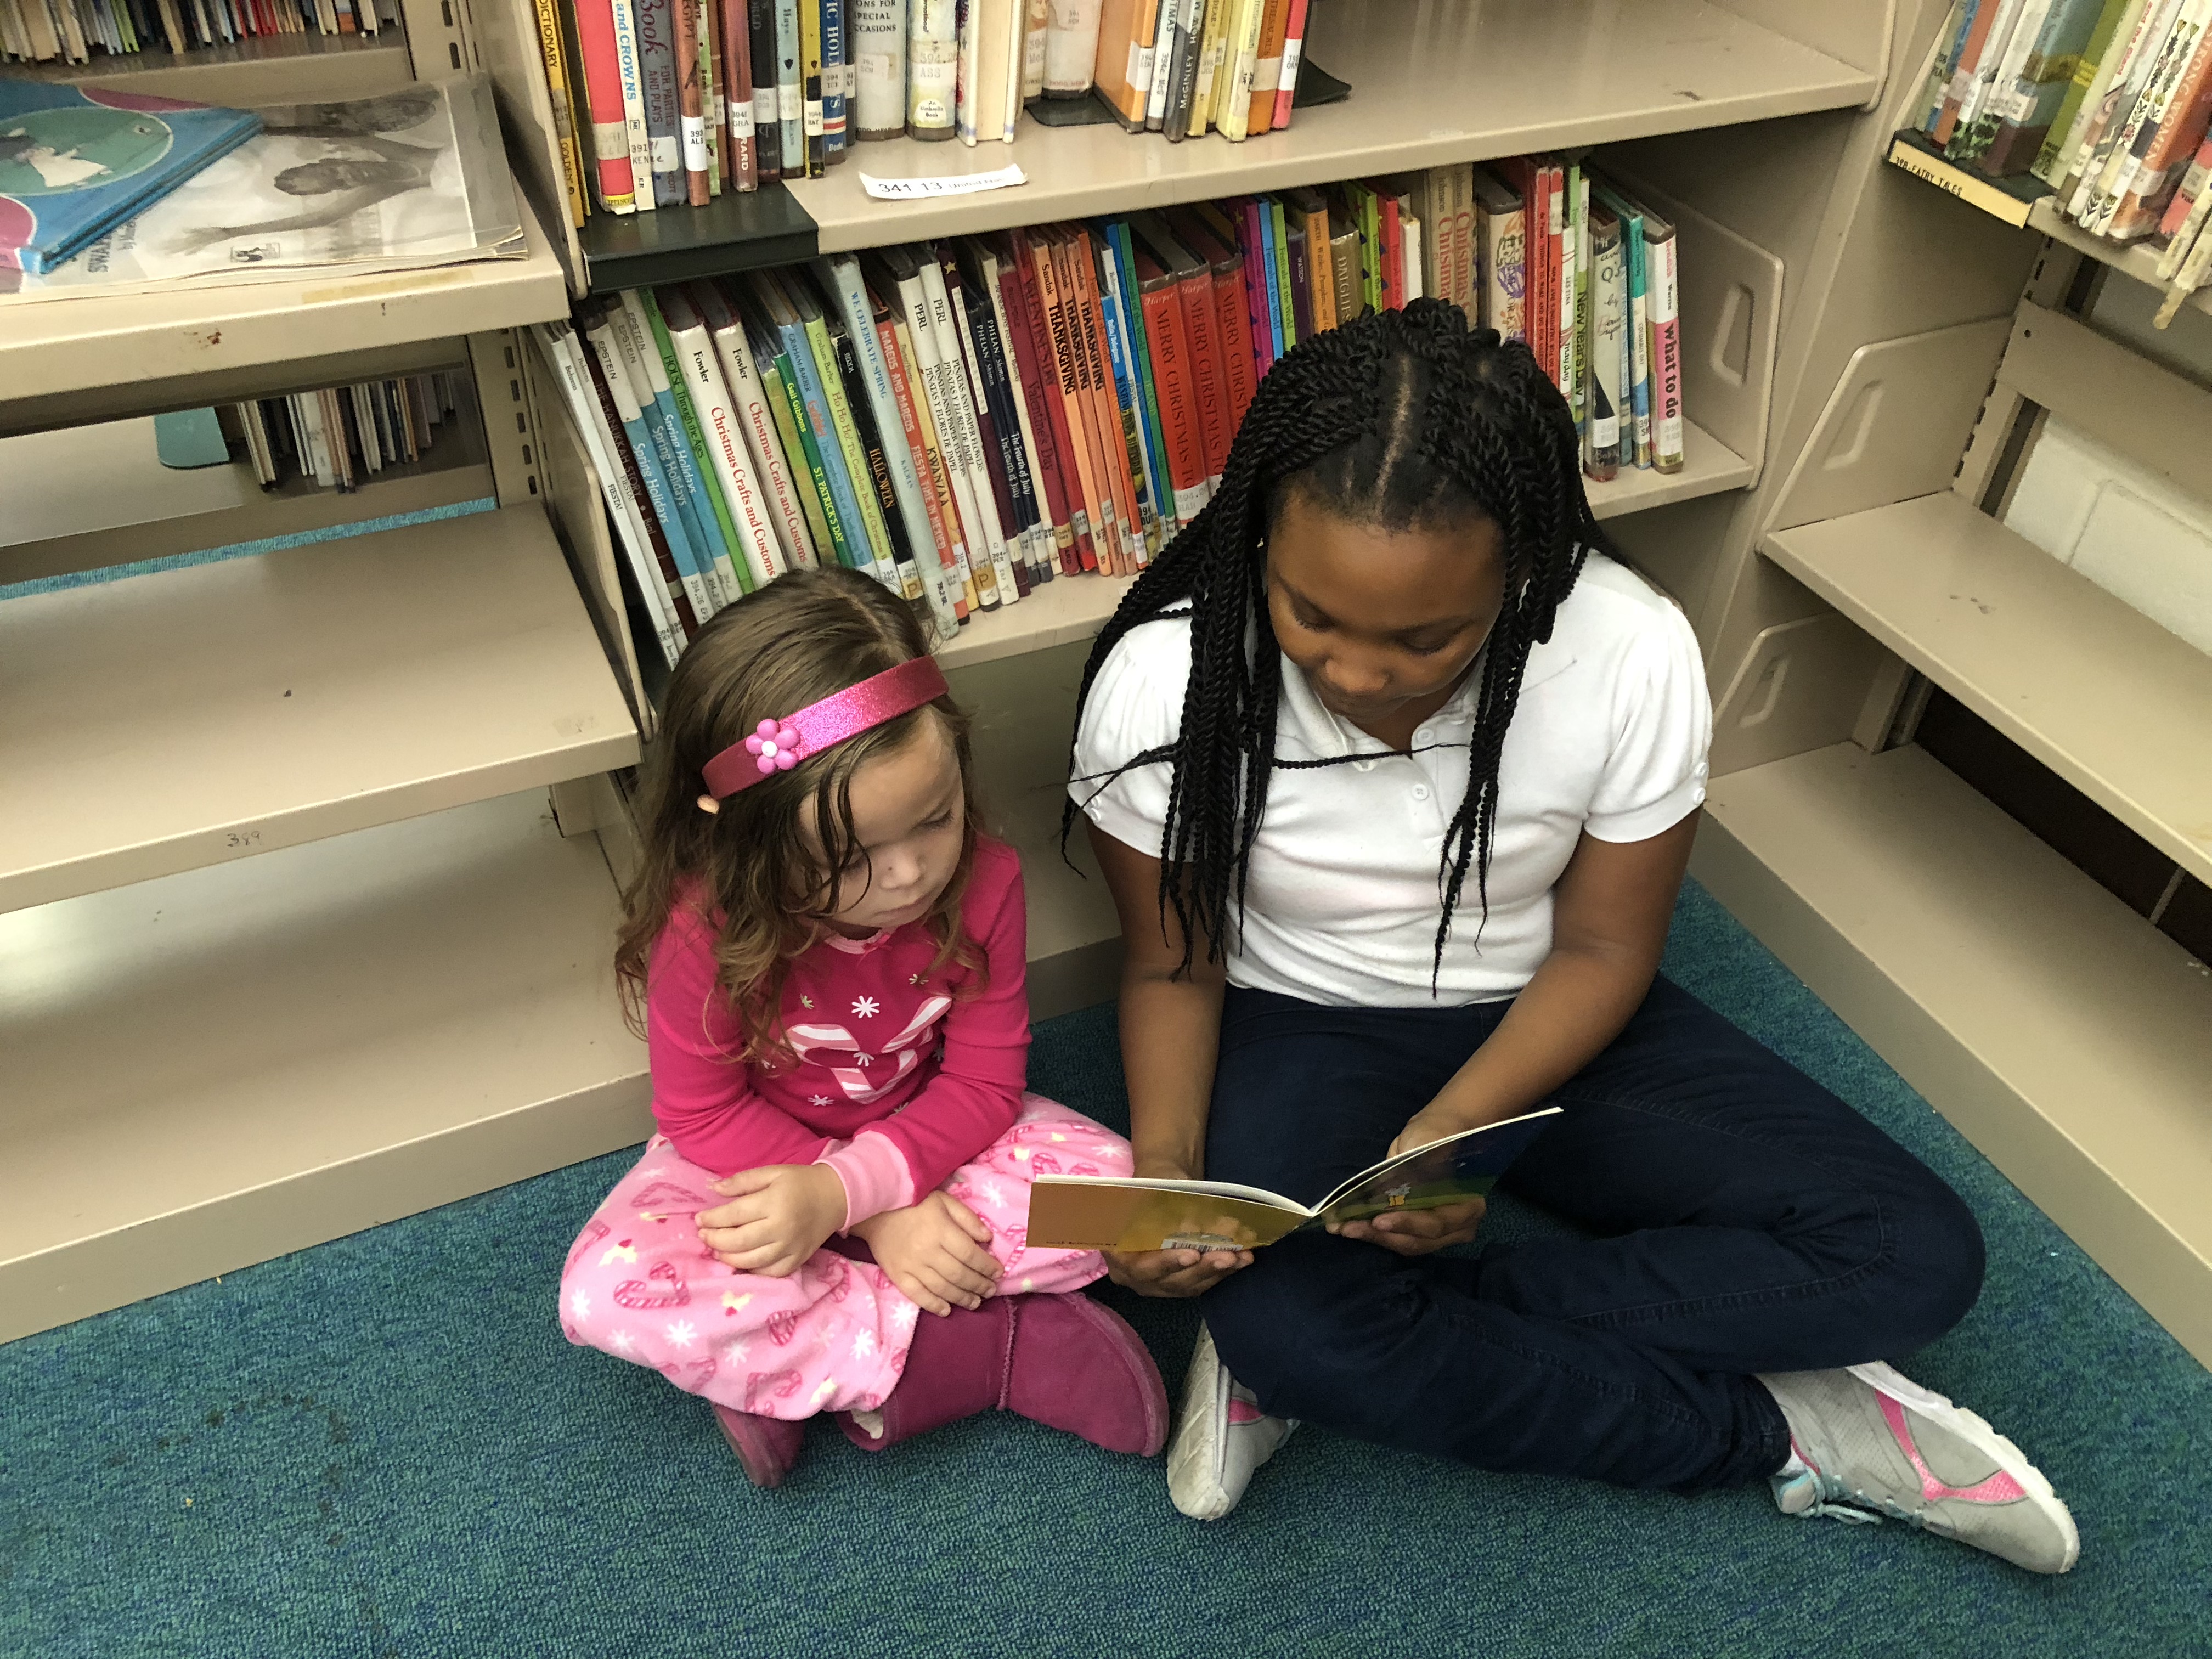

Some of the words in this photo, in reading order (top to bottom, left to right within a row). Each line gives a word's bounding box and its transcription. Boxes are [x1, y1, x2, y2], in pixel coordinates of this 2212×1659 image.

[616, 3, 629, 31] and
[648, 70, 659, 90] AND
[661, 66, 670, 84] FOR
[919, 67, 941, 78] ASS
[1180, 55, 1194, 109] McGINLEY
[664, 88, 675, 127] PARTIES
[878, 183, 912, 193] 341
[921, 182, 943, 190] 13
[1437, 177, 1447, 212] Johnson
[1265, 246, 1274, 279] Festivals
[1279, 246, 1289, 281] Festivals
[1438, 217, 1453, 301] Christma
[1456, 212, 1471, 301] Christmas
[1268, 279, 1274, 289] of
[1282, 280, 1288, 290] of
[914, 302, 928, 331] PERL
[933, 298, 947, 326] PERL
[1058, 258, 1069, 291] Sandak
[1065, 295, 1090, 391] THANKSGIVING
[1222, 291, 1240, 348] MERRY
[1271, 305, 1280, 330] World
[1285, 306, 1294, 330] World
[1576, 291, 1585, 325] New
[628, 312, 646, 351] EPSTEIN
[1042, 263, 1054, 296] Sandak
[1048, 301, 1076, 396] THANKSGIVING
[1074, 259, 1085, 291] Sandak
[1080, 297, 1105, 392] THANKSGIVING
[1155, 308, 1176, 365] MERRY
[1190, 298, 1209, 353] MERRY
[598, 340, 618, 380] EPSTEIN
[618, 324, 637, 364] EPSTEIN
[815, 332, 827, 361] Graham
[851, 291, 861, 307] WE
[856, 308, 878, 365] CELEBRATE
[873, 365, 888, 399] SPRING
[663, 355, 680, 387] HOUSE
[693, 350, 710, 384] Fowler
[732, 347, 748, 380] Fowler
[788, 332, 802, 368] GRAHAM
[798, 367, 812, 393] BARBER
[823, 360, 834, 385] Barber
[787, 382, 798, 400] Gail
[832, 391, 843, 407] Ho
[1229, 352, 1249, 424] CHRIST
[1575, 370, 1585, 396] Day
[1664, 375, 1677, 394] to
[677, 391, 693, 424] Through
[792, 399, 807, 433] Gibbons
[837, 407, 846, 423] Ho
[1165, 369, 1192, 465] CHRISTMAS
[1197, 358, 1222, 450] CHRISTMAS
[1665, 397, 1679, 419] do
[687, 420, 698, 438] the
[711, 407, 738, 469] Christmas
[749, 401, 774, 461] Christmas
[842, 423, 853, 442] Ho!
[943, 437, 951, 449] DE
[1011, 432, 1020, 447] The
[664, 414, 681, 448] Spring
[676, 449, 697, 494] Holidays
[691, 439, 704, 458] Ages
[847, 442, 855, 459] The
[946, 450, 958, 474] PAPEL
[963, 444, 974, 465] PAPEL
[1003, 449, 1014, 474] Fourth
[1013, 445, 1027, 470] Fourth
[652, 425, 671, 461] Spring
[664, 462, 687, 507] Holidays
[769, 460, 788, 496] Crafts
[851, 458, 866, 492] Complete
[869, 447, 895, 509] HALLOWEEN
[633, 442, 652, 477] Spring
[648, 478, 669, 524] Holidays
[732, 468, 752, 506] Crafts
[1020, 478, 1031, 495] July
[745, 506, 763, 528] and
[780, 496, 796, 517] and
[861, 493, 872, 511] Book
[866, 510, 873, 519] of
[787, 517, 807, 563] Customs
[832, 523, 844, 543] DAY
[869, 517, 883, 555] Christmas
[753, 528, 776, 577] Customs
